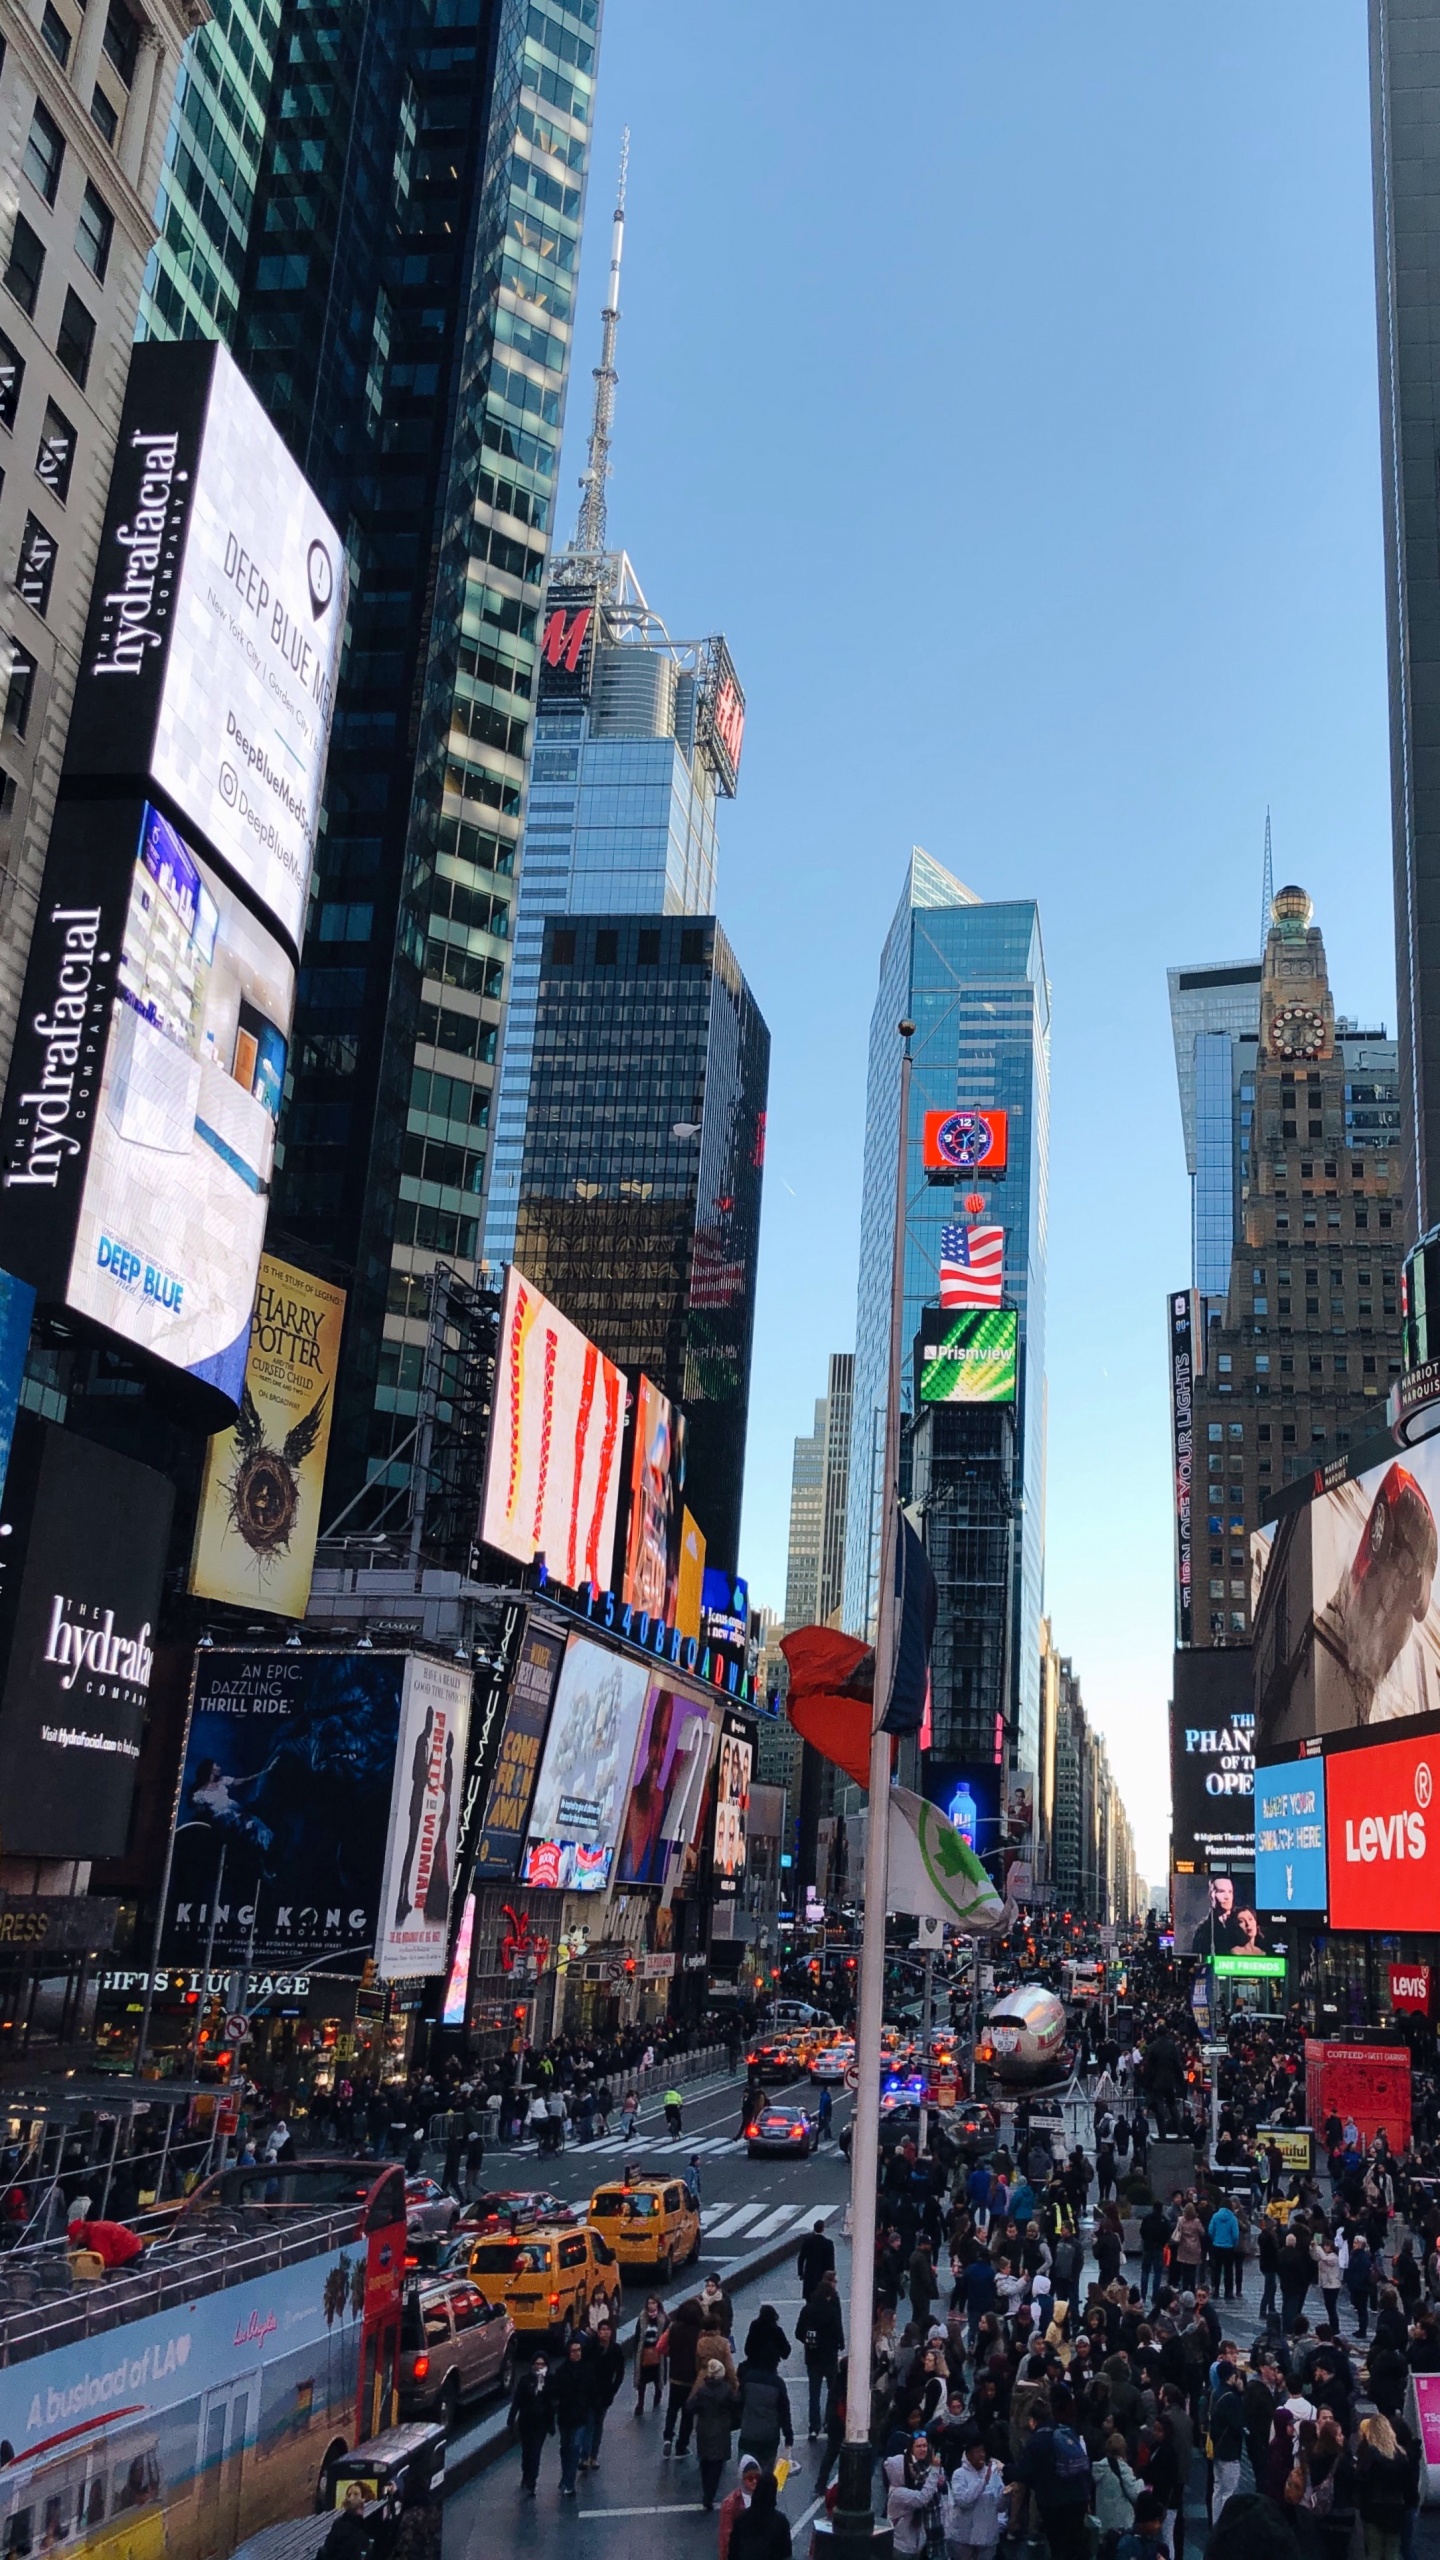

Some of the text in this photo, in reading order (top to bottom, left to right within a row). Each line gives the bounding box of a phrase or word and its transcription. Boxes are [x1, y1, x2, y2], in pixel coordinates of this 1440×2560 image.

[94, 430, 182, 675] hydrafacial
[157, 499, 185, 616] COMPANY
[224, 530, 270, 618] DEEP
[271, 598, 313, 687] BLUE
[207, 587, 308, 738] New York City Garden City
[6, 905, 102, 1188] hydrafacial
[76, 983, 107, 1118] COMPANY
[960, 1118, 972, 1127] 12
[11, 1117, 29, 1168] THE
[944, 1134, 987, 1142] 9 3
[960, 1152, 969, 1160] 6
[97, 1235, 184, 1314] DEEP BLUE
[115, 1278, 142, 1296] med
[263, 1265, 269, 1274] IS
[270, 1267, 284, 1281] THE
[285, 1275, 304, 1289] STUFF
[305, 1283, 314, 1293] OF
[256, 1283, 326, 1342] HARRY
[249, 1314, 324, 1375] POTTER
[938, 1345, 1012, 1361] Prismview
[252, 1357, 314, 1390] CURSED CHILD
[258, 1389, 301, 1411] ON BROADWAY
[1175, 1352, 1191, 1428] LIGHTS
[1178, 1433, 1192, 1495] YOUR
[66, 1599, 100, 1620] THE
[378, 1621, 419, 1632] LAMAR
[586, 1581, 648, 1645] 1540
[655, 1619, 760, 1704] BROADWAY
[211, 1681, 283, 1696] DAZZLING
[413, 1680, 429, 1695] GOOD
[443, 1672, 461, 1690] REALLY
[200, 1697, 248, 1713] THRILL
[42, 1724, 58, 1743] Visit
[1184, 1728, 1254, 1752] PHAN
[427, 1710, 447, 1797] PRETTY
[502, 1730, 541, 1767] COME
[1220, 1755, 1239, 1770] OF
[488, 1796, 529, 1832] AWAY
[1296, 1825, 1322, 1849] HERE
[1345, 1809, 1427, 1863] LEVI'S
[413, 1813, 436, 1910] WOMAN
[0, 1912, 49, 1942] RESS
[176, 1902, 367, 1930] KING KONG
[275, 1927, 366, 1938] BROADWAY
[1237, 1960, 1280, 1972] FRIENDS
[97, 1971, 168, 1992] GIFTS
[1393, 1976, 1427, 1998] LEVI'S
[26, 2338, 177, 2432] A busload of LA
